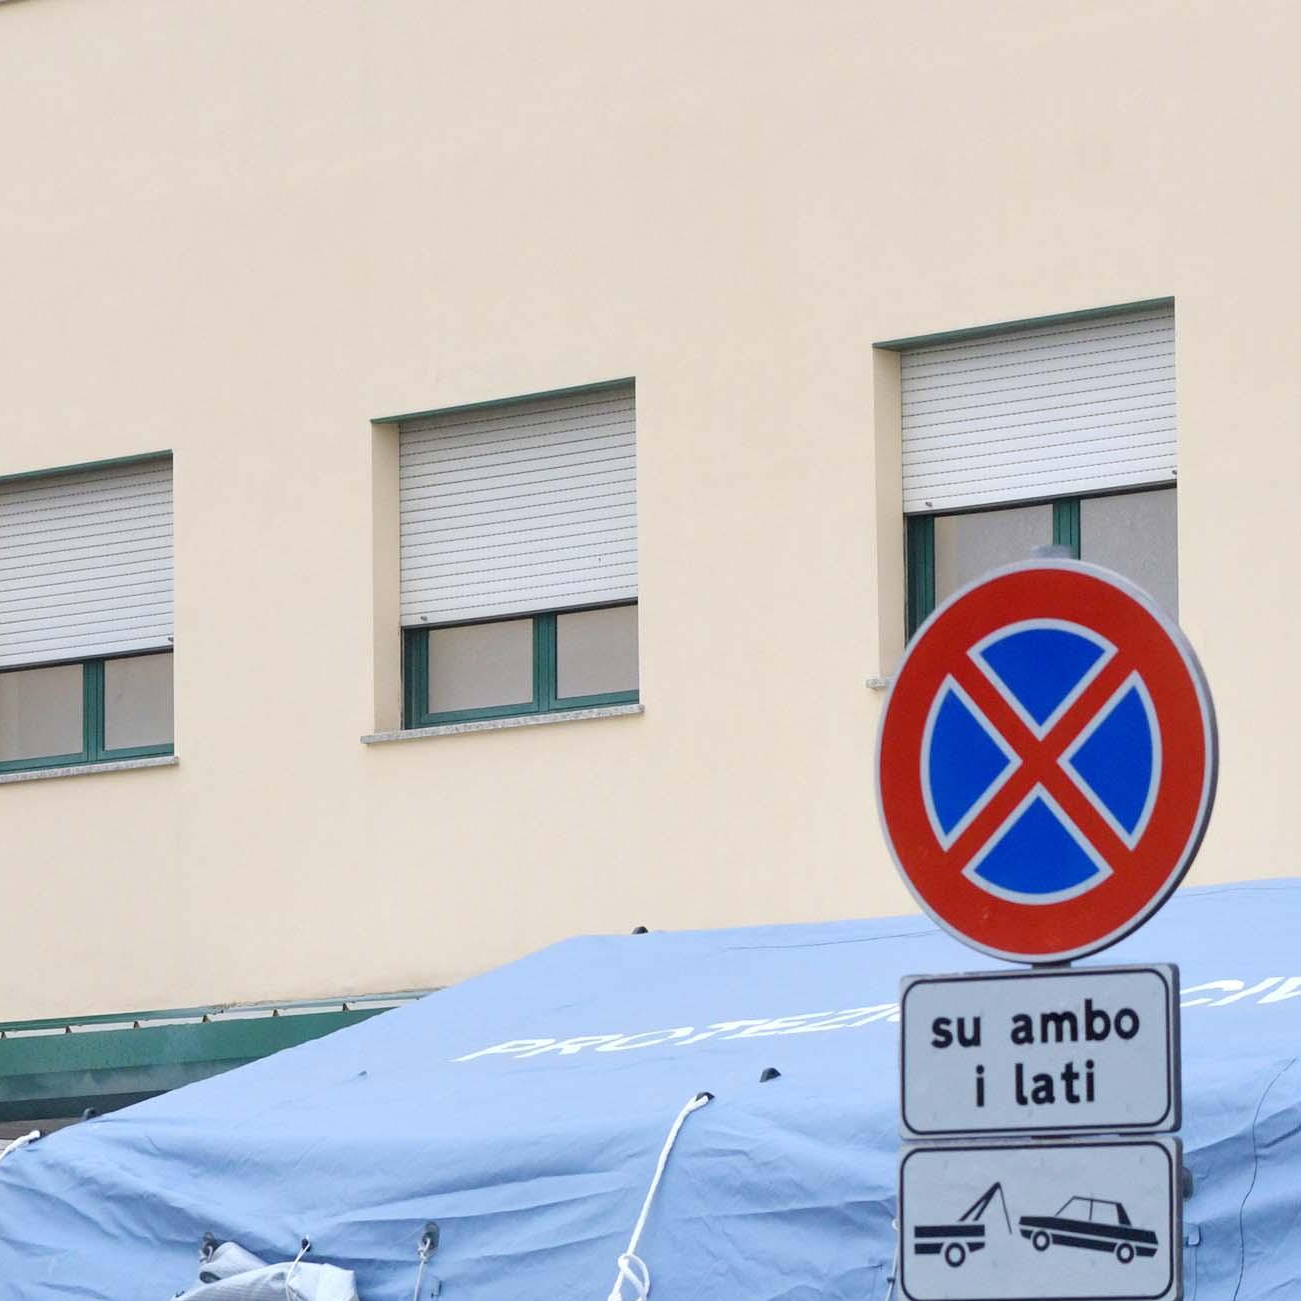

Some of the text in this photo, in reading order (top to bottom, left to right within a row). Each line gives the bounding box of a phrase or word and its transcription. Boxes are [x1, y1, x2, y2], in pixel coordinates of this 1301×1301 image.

[931, 998, 1140, 1048] su ambo
[975, 1059, 1095, 1107] i lati
